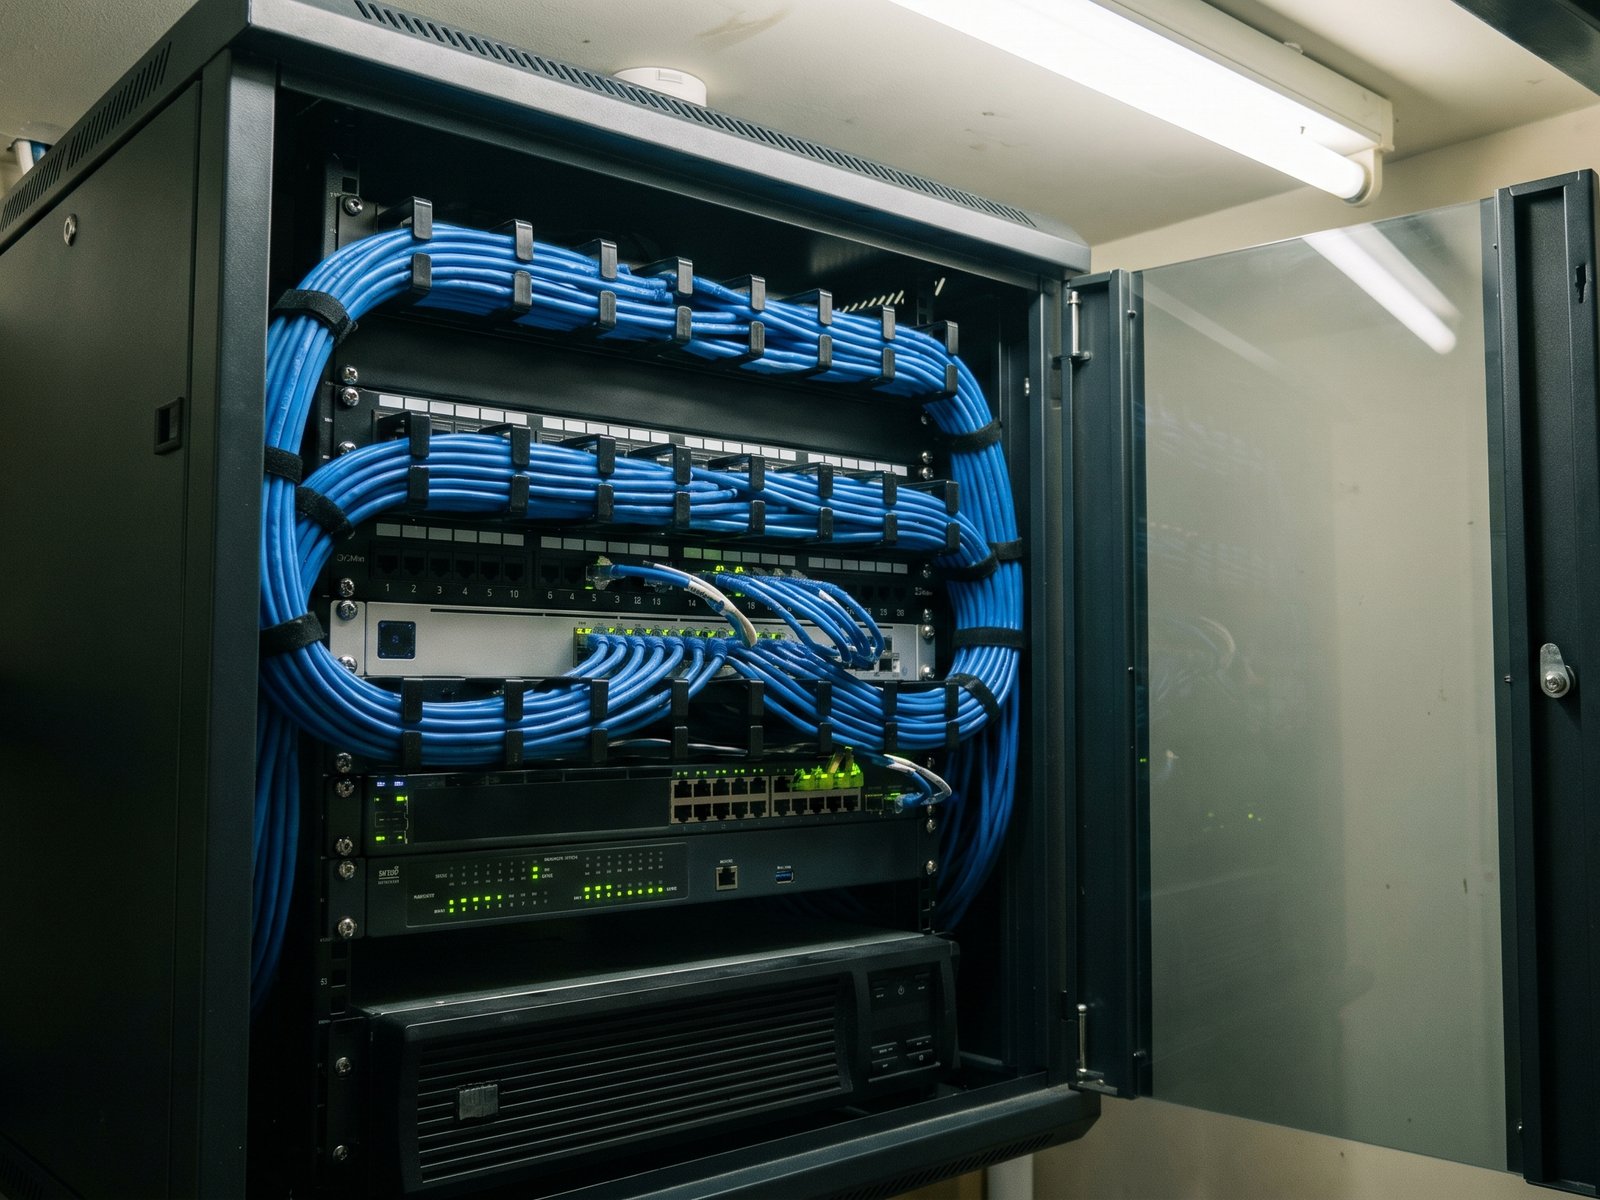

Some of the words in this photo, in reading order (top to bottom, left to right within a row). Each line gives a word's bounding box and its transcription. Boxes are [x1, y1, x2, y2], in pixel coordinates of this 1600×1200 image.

[411, 584, 417, 593] 2
[436, 585, 442, 595] 3
[462, 587, 468, 596] 4
[487, 588, 493, 597] 5
[510, 589, 519, 599] 10
[614, 595, 620, 604] 3
